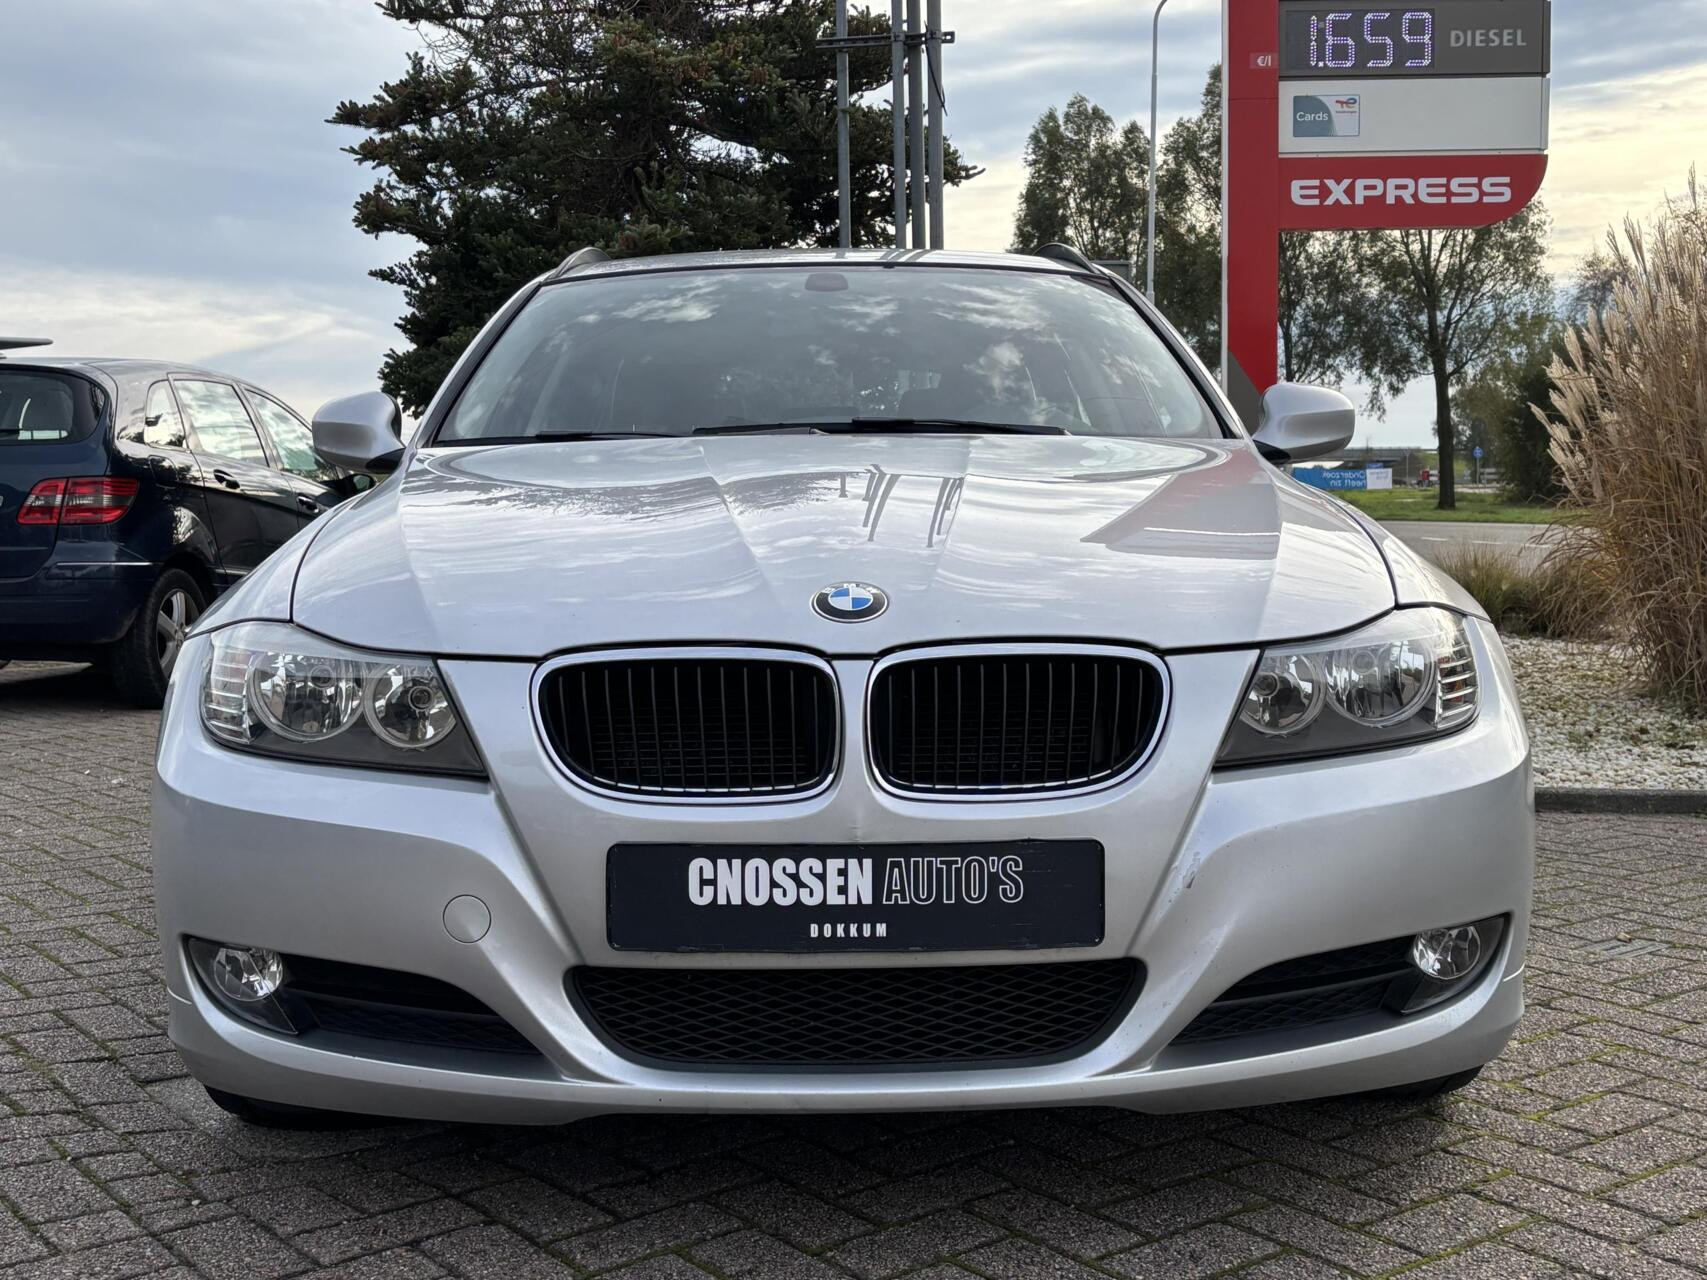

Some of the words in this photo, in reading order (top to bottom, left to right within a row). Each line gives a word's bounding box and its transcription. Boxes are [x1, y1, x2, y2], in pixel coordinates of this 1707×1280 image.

[1450, 29, 1527, 47] DIESEL
[1296, 111, 1329, 122] Cards
[1290, 177, 1512, 206] EXPRESS
[688, 857, 873, 906] CNOSSEN
[882, 856, 1025, 905] AUTO'S
[810, 923, 888, 938] DOKKUM
